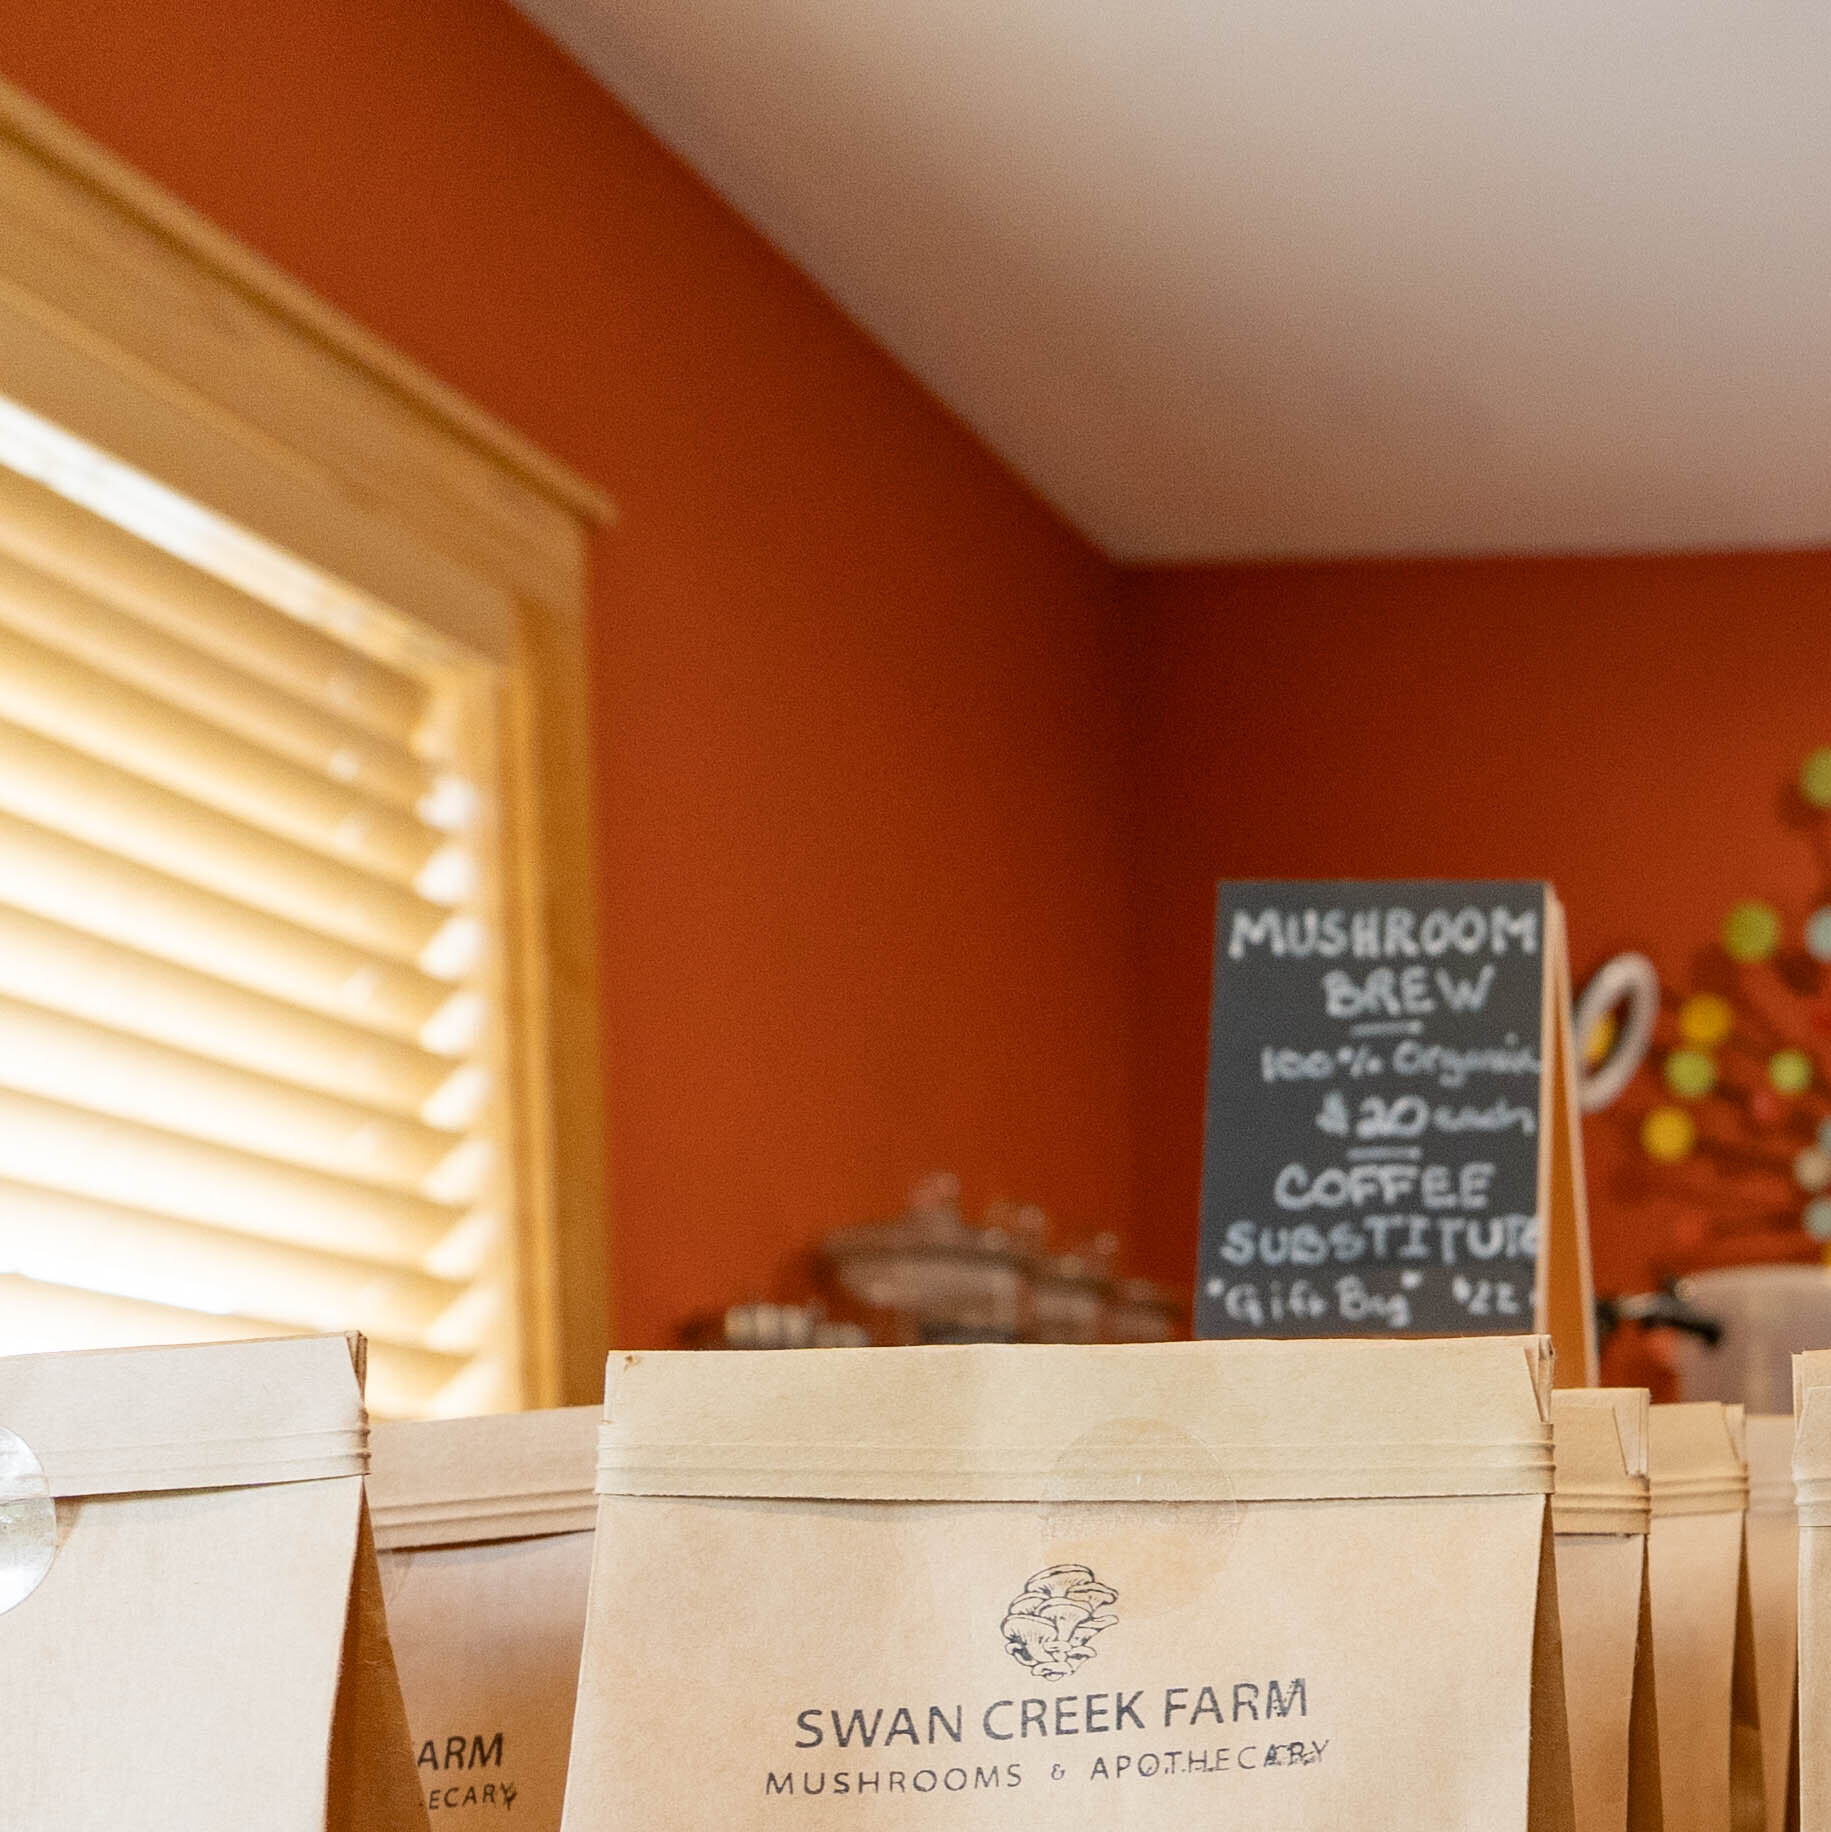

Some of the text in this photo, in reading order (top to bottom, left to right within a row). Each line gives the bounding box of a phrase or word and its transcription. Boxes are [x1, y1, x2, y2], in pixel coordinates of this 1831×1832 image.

[1228, 907, 1538, 960] MUSHROOM
[1322, 963, 1496, 1018] BREW
[1273, 1160, 1497, 1210] COFFEE
[793, 1677, 1308, 1750] SWAN CREEK FARM
[416, 1731, 504, 1771] ARM
[764, 1763, 1022, 1797] MUSHROOMS
[1089, 1739, 1330, 1781] APOTHECARY
[428, 1781, 519, 1812] ECARY
